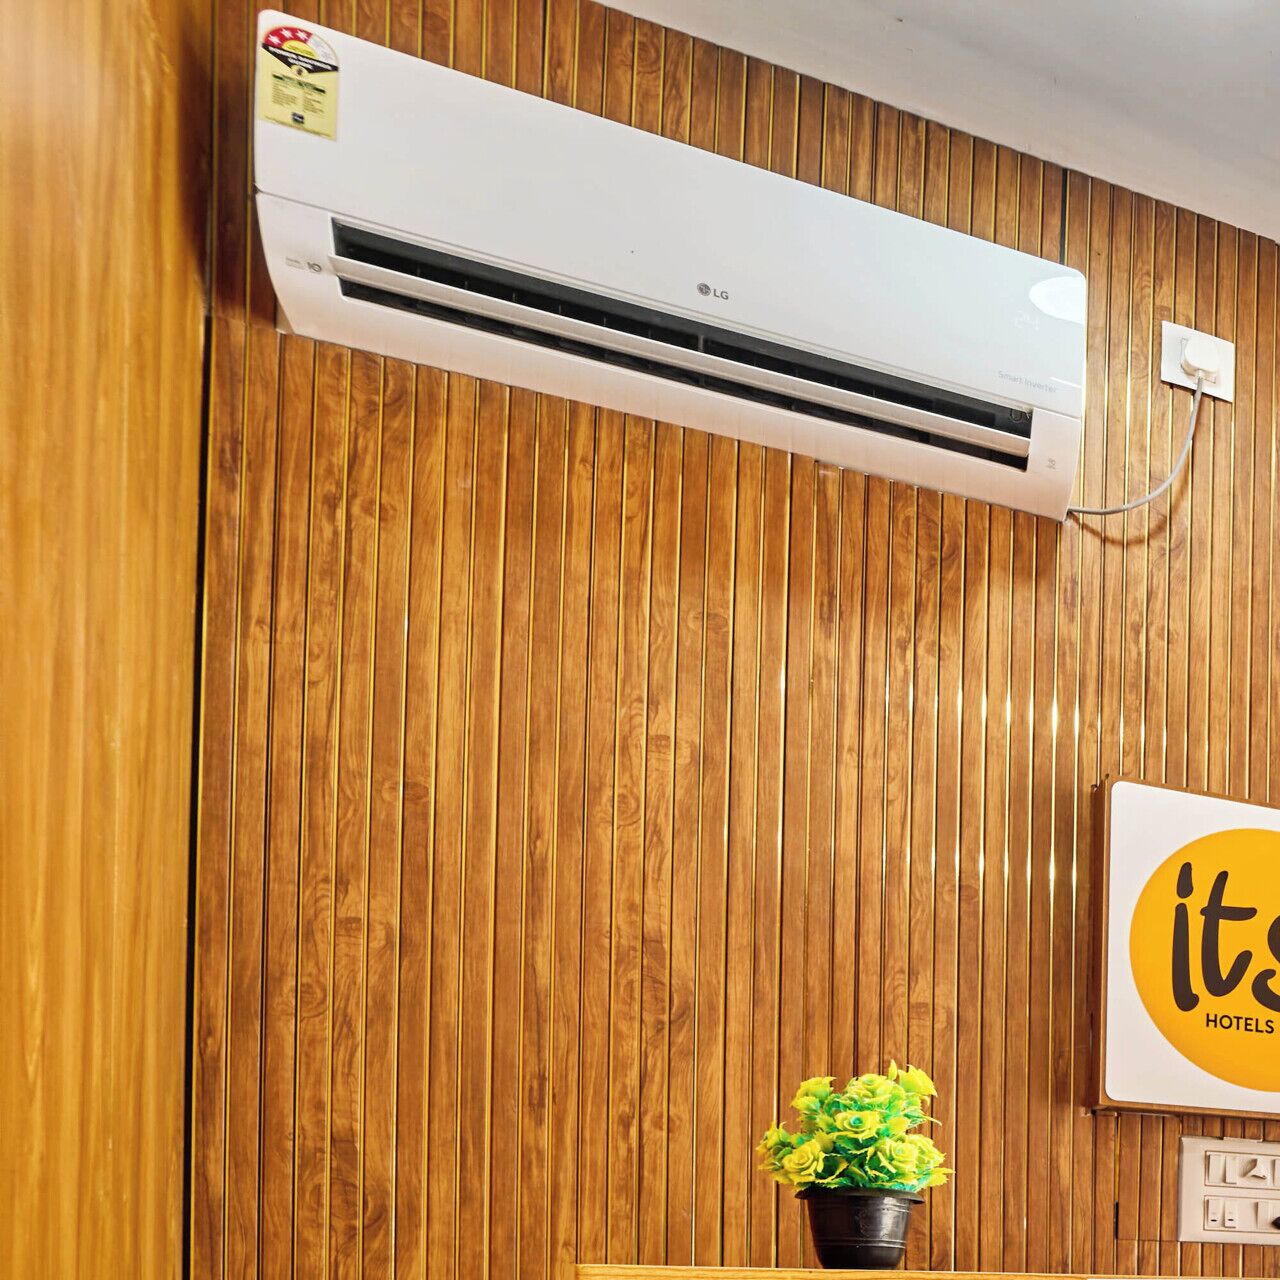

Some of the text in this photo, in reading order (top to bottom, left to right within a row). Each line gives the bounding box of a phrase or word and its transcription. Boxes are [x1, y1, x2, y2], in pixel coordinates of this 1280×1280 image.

[713, 288, 729, 300] LG
[998, 370, 1057, 393] Smart Inverter
[1206, 1013, 1275, 1034] HOTELS
